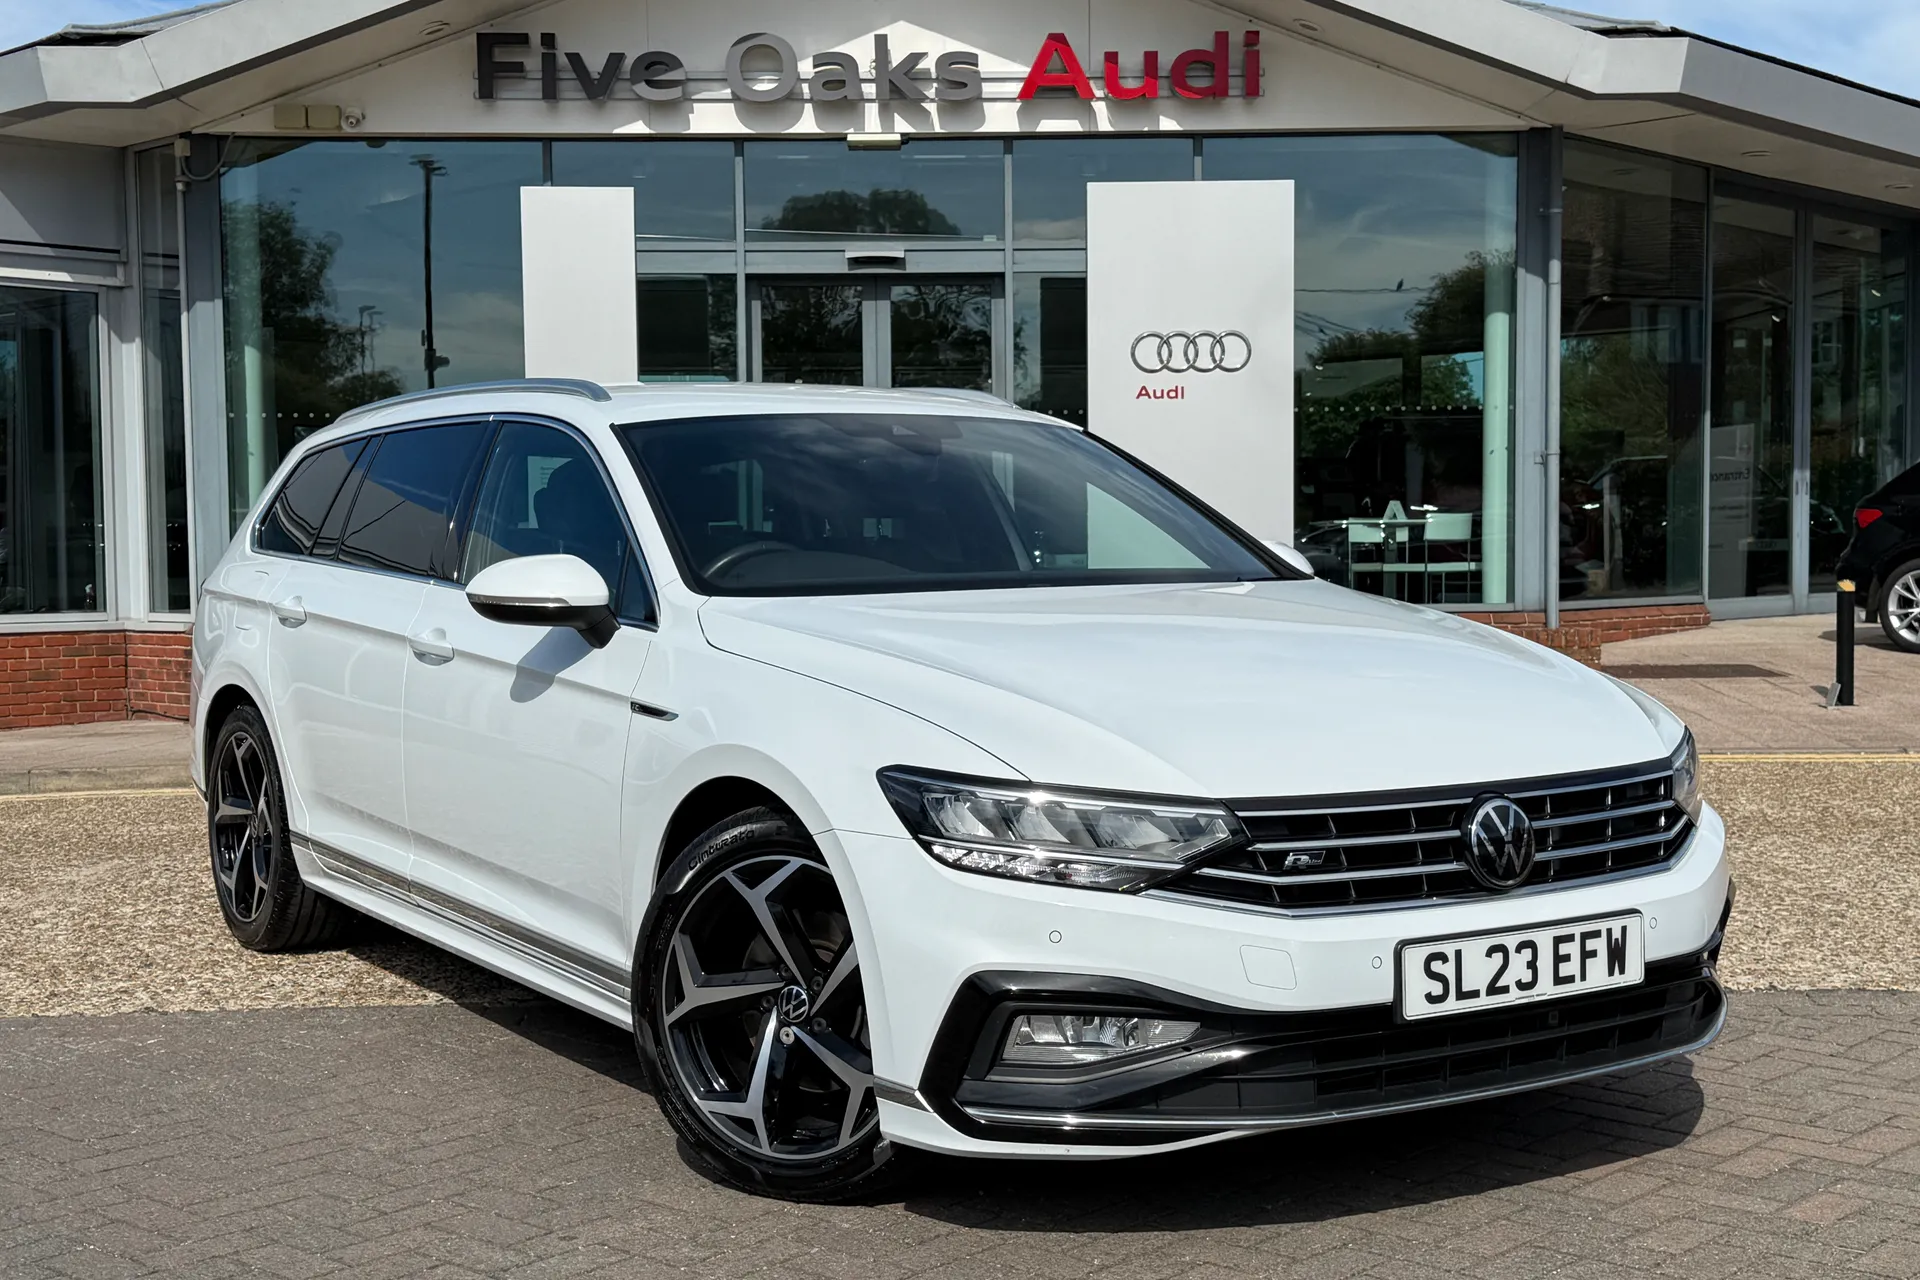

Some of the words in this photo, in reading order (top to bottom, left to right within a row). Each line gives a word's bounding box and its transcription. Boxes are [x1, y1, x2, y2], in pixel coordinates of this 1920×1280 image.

[476, 32, 687, 101] Five
[725, 32, 983, 103] Oaks
[1016, 30, 1261, 101] Audi
[1135, 385, 1185, 400] Audi
[1423, 939, 1539, 1005] SL23
[1552, 925, 1628, 987] EFW
